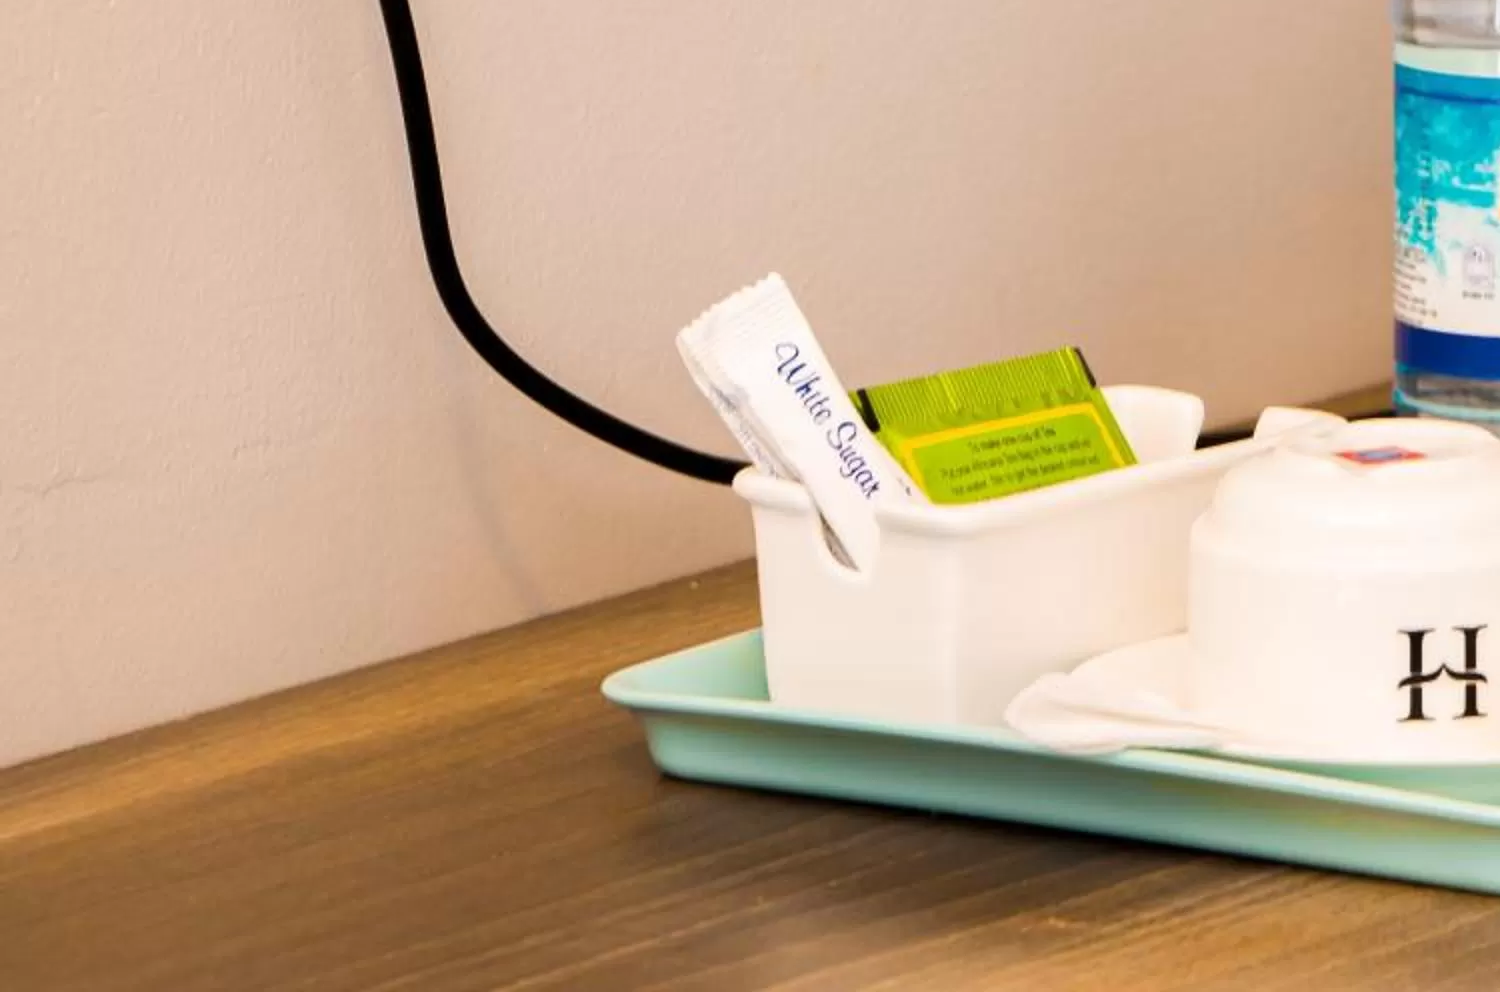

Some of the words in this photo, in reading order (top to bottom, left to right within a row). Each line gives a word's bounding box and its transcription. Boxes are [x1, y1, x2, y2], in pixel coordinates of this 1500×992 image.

[775, 341, 832, 425] White
[826, 421, 881, 500] Sugar
[1397, 623, 1489, 722] H
